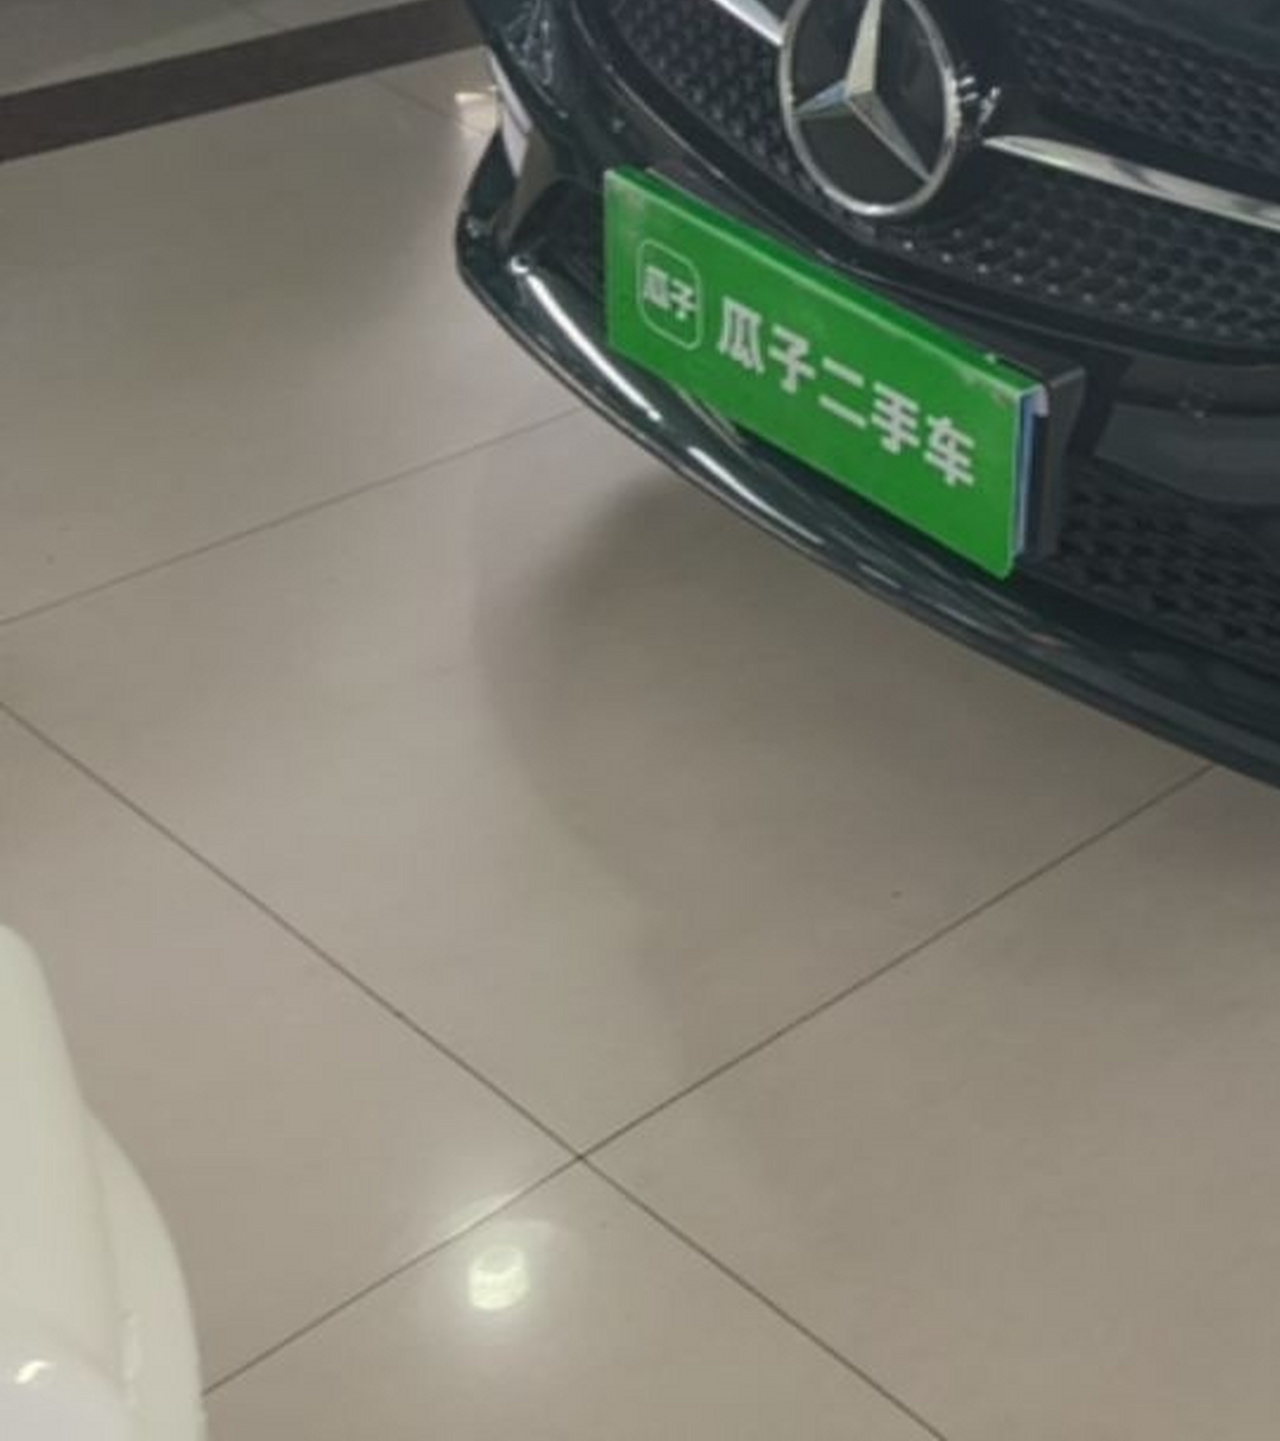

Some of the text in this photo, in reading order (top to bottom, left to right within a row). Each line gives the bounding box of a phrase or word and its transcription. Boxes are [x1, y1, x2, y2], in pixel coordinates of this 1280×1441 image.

[642, 262, 699, 323] 瓜子
[716, 294, 976, 488] 瓜子二手车
